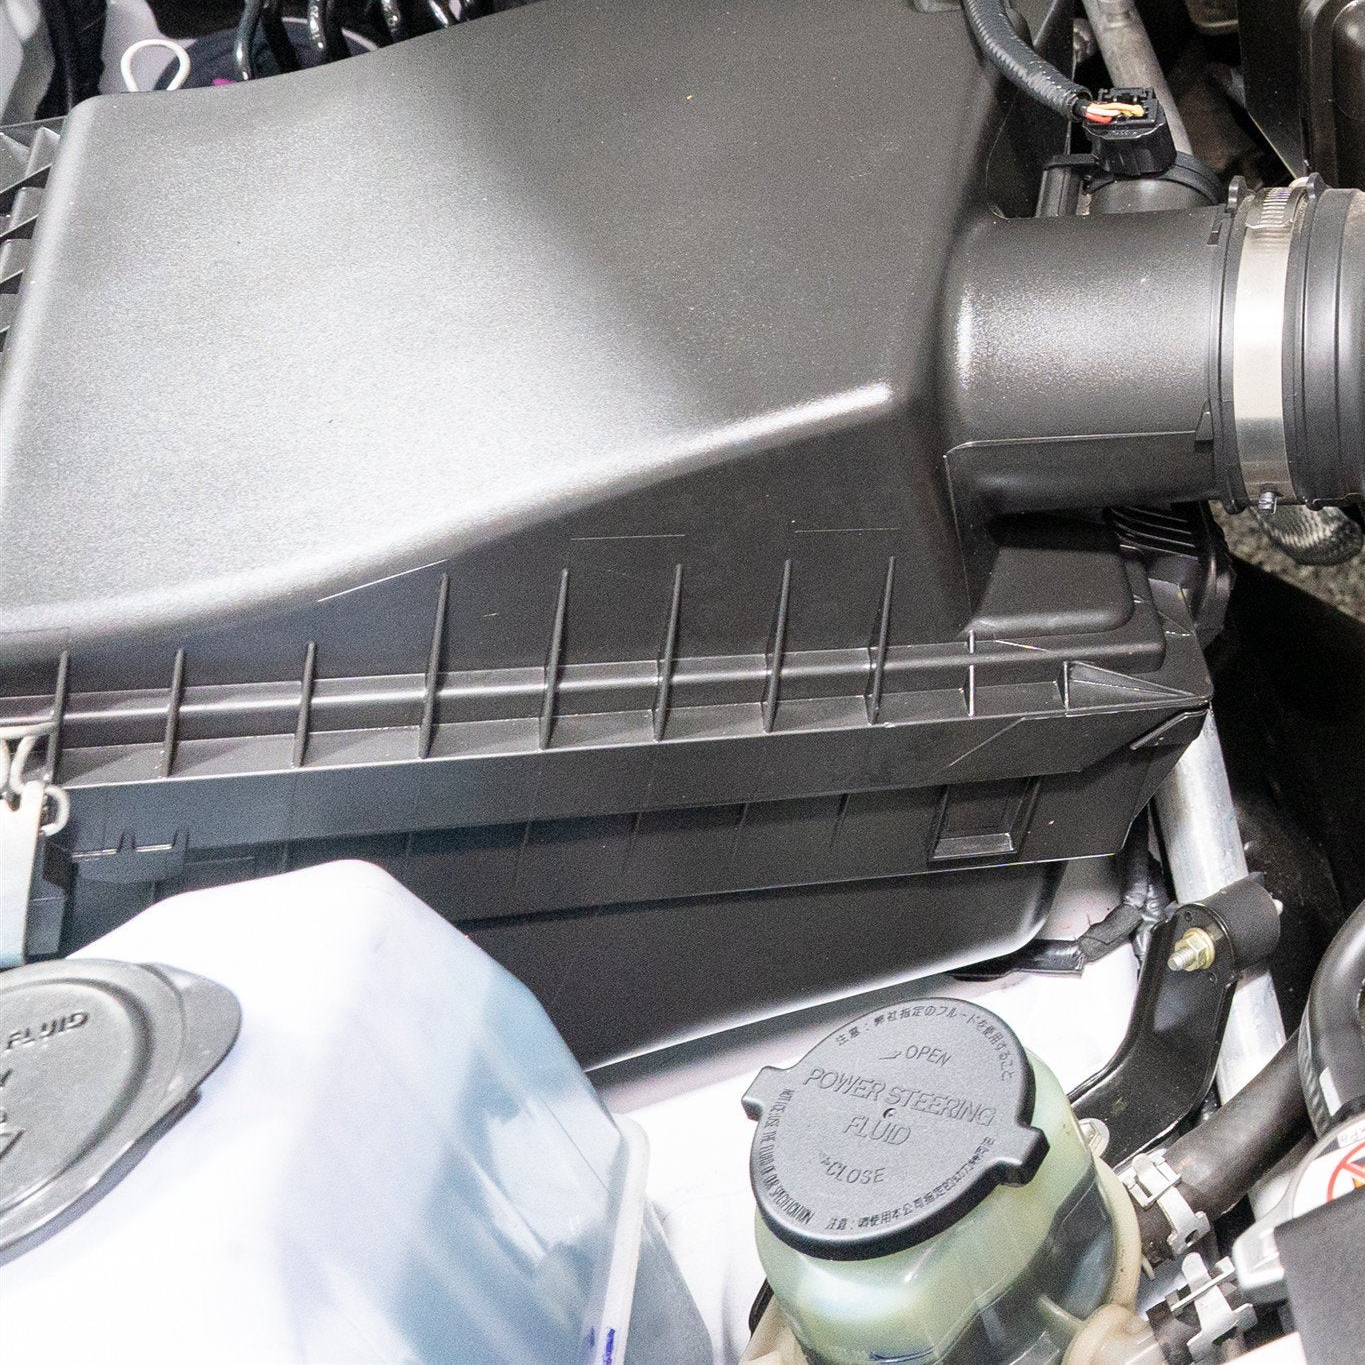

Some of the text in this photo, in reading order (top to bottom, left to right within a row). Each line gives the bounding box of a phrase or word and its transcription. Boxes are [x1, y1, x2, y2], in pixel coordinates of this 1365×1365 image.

[4, 1010, 91, 1051] FLUID
[904, 1045, 953, 1067] OPEN
[803, 1067, 998, 1127] POWER STEERING
[842, 1115, 912, 1146] FLUID
[826, 1162, 887, 1185] CLOSE
